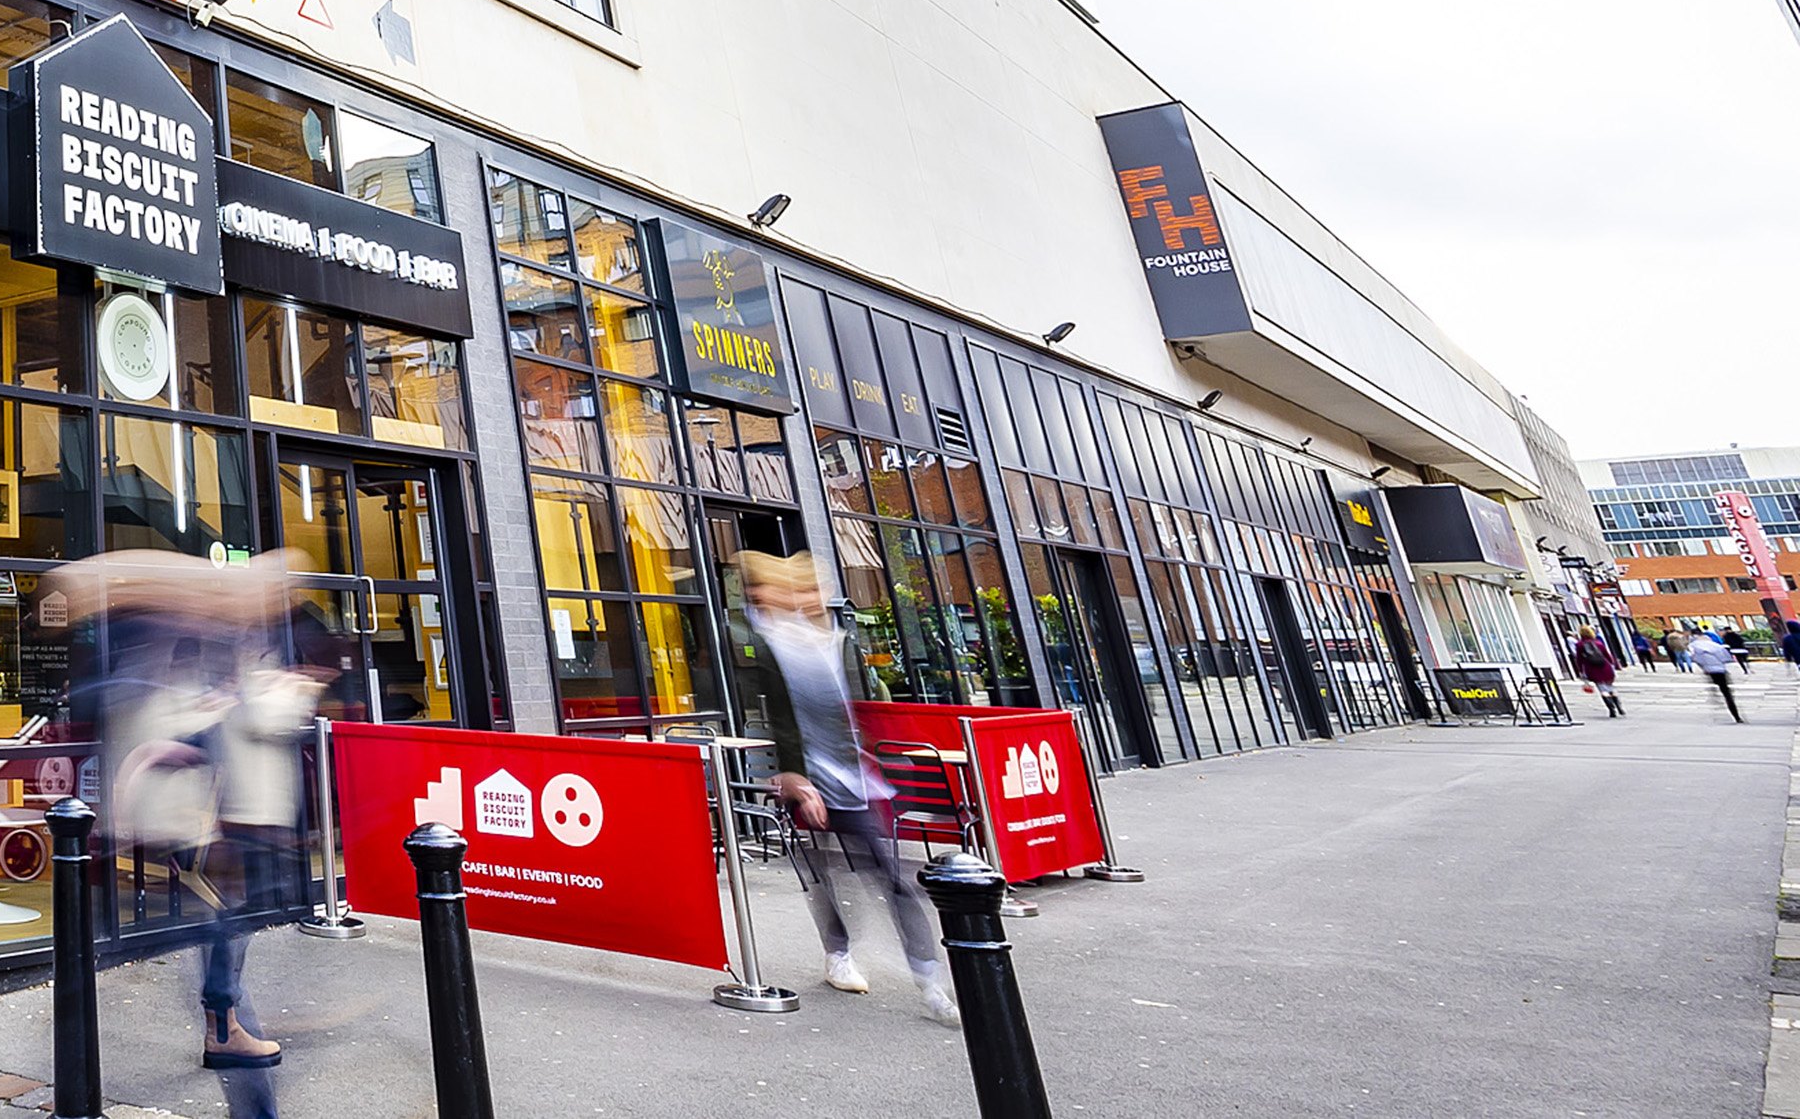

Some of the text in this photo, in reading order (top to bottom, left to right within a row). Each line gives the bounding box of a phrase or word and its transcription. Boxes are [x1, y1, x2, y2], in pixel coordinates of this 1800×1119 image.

[60, 85, 197, 162] READING
[61, 133, 198, 208] BISCUIT
[63, 183, 201, 255] FACTORY
[221, 201, 315, 256] CINEMA
[334, 232, 397, 274] FOOD
[412, 254, 458, 290] BAR
[1145, 247, 1227, 269] FOUNTAIN
[1173, 258, 1232, 278] HOUSE
[692, 320, 776, 378] SPINNERS
[809, 366, 921, 415] PLAY DRINK EAT
[1715, 495, 1761, 577] HEXAGON
[483, 791, 525, 804] READING
[483, 803, 526, 816] BISCUIT
[484, 816, 526, 829] FACTORY
[461, 861, 488, 875] CAFE
[495, 865, 516, 879] BAR
[522, 869, 563, 884] EVENTS
[570, 874, 604, 889] FOOD
